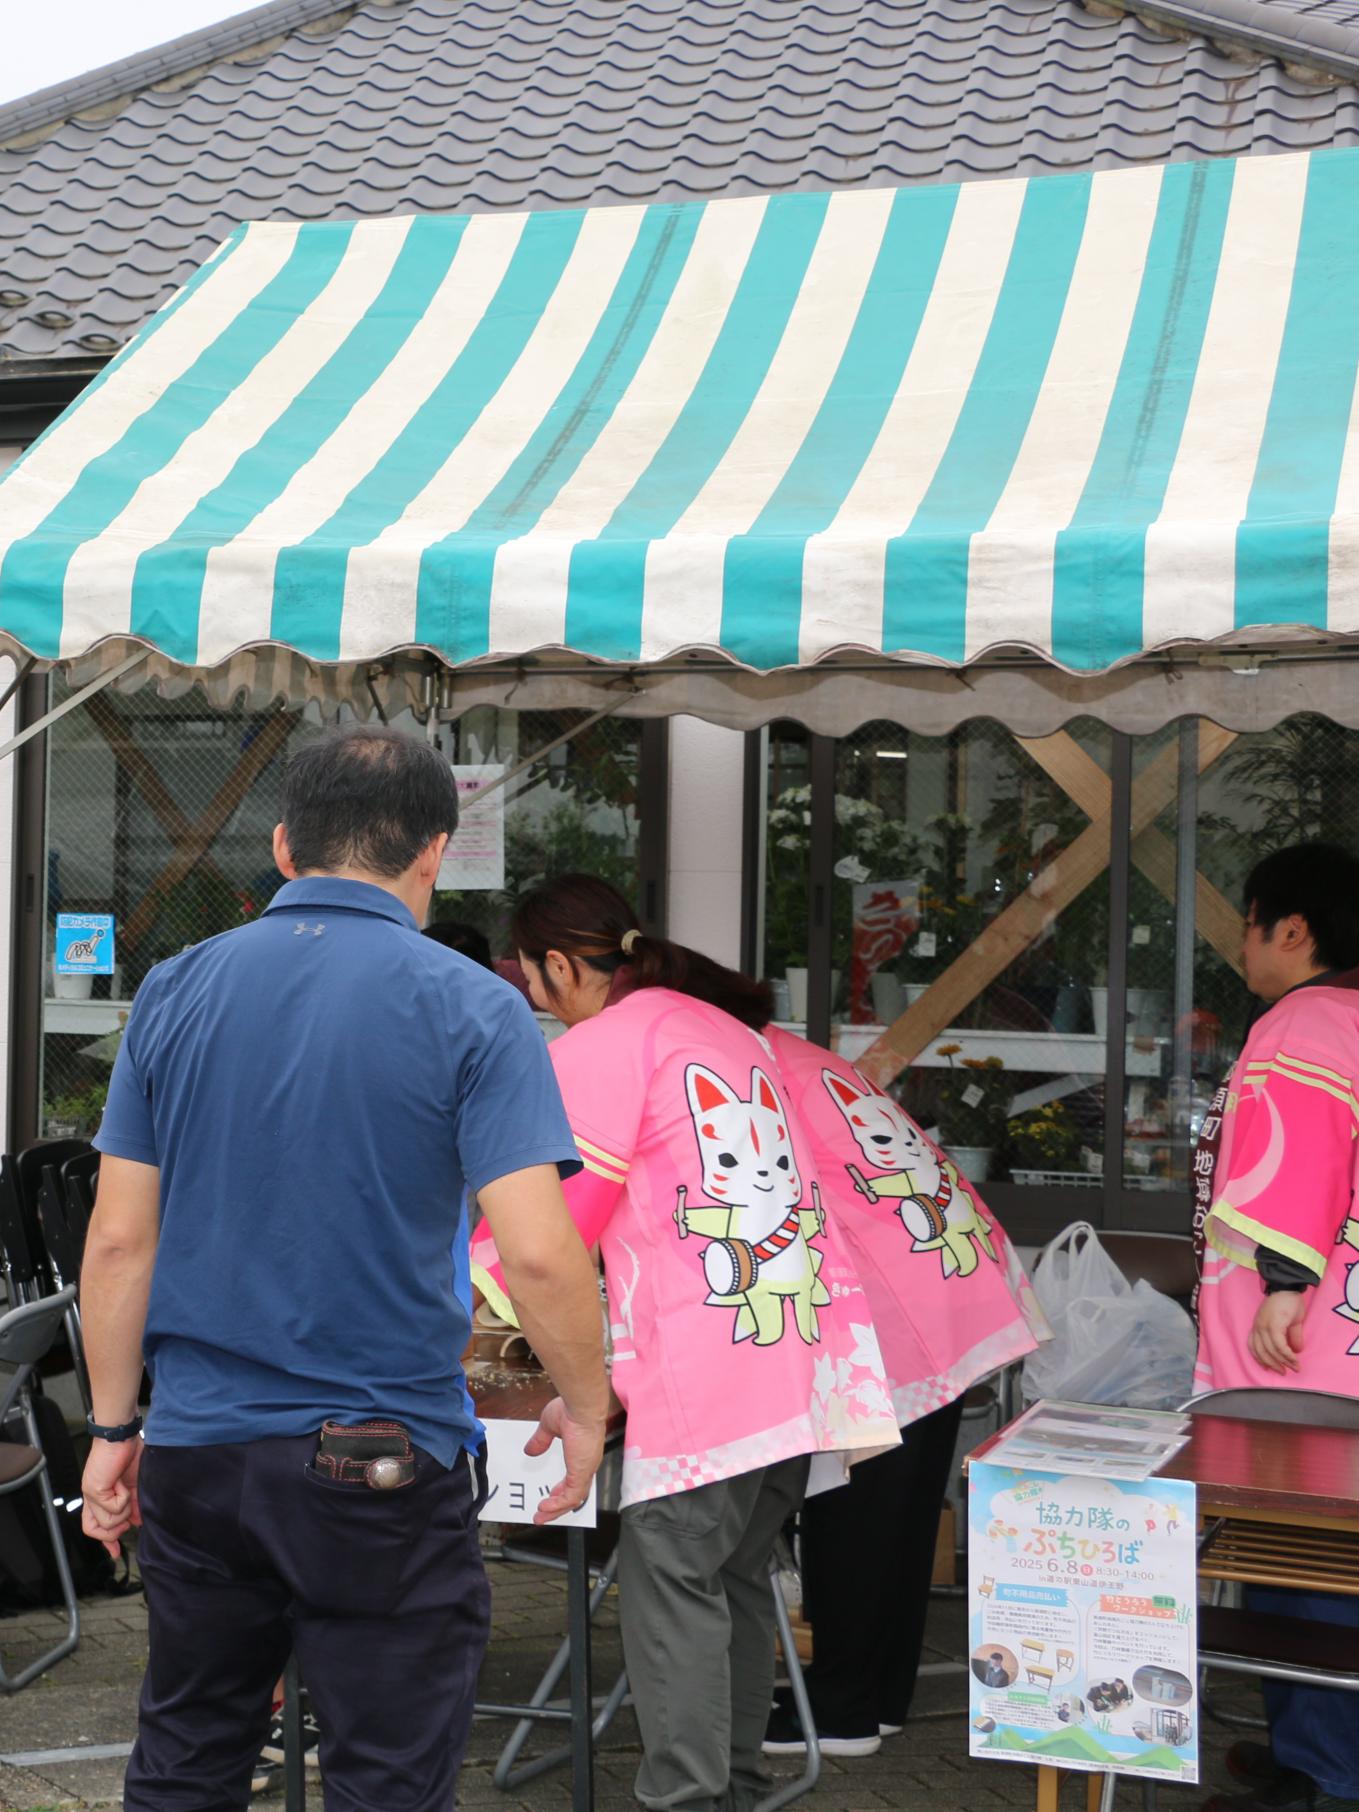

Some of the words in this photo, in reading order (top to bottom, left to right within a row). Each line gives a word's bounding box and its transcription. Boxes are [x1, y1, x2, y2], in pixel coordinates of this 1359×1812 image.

[1036, 1501, 1130, 1531] 協力隊の
[1023, 1528, 1143, 1564] ぷちひろば
[1011, 1557, 1043, 1570] 2025
[1047, 1558, 1078, 1575] 6.8
